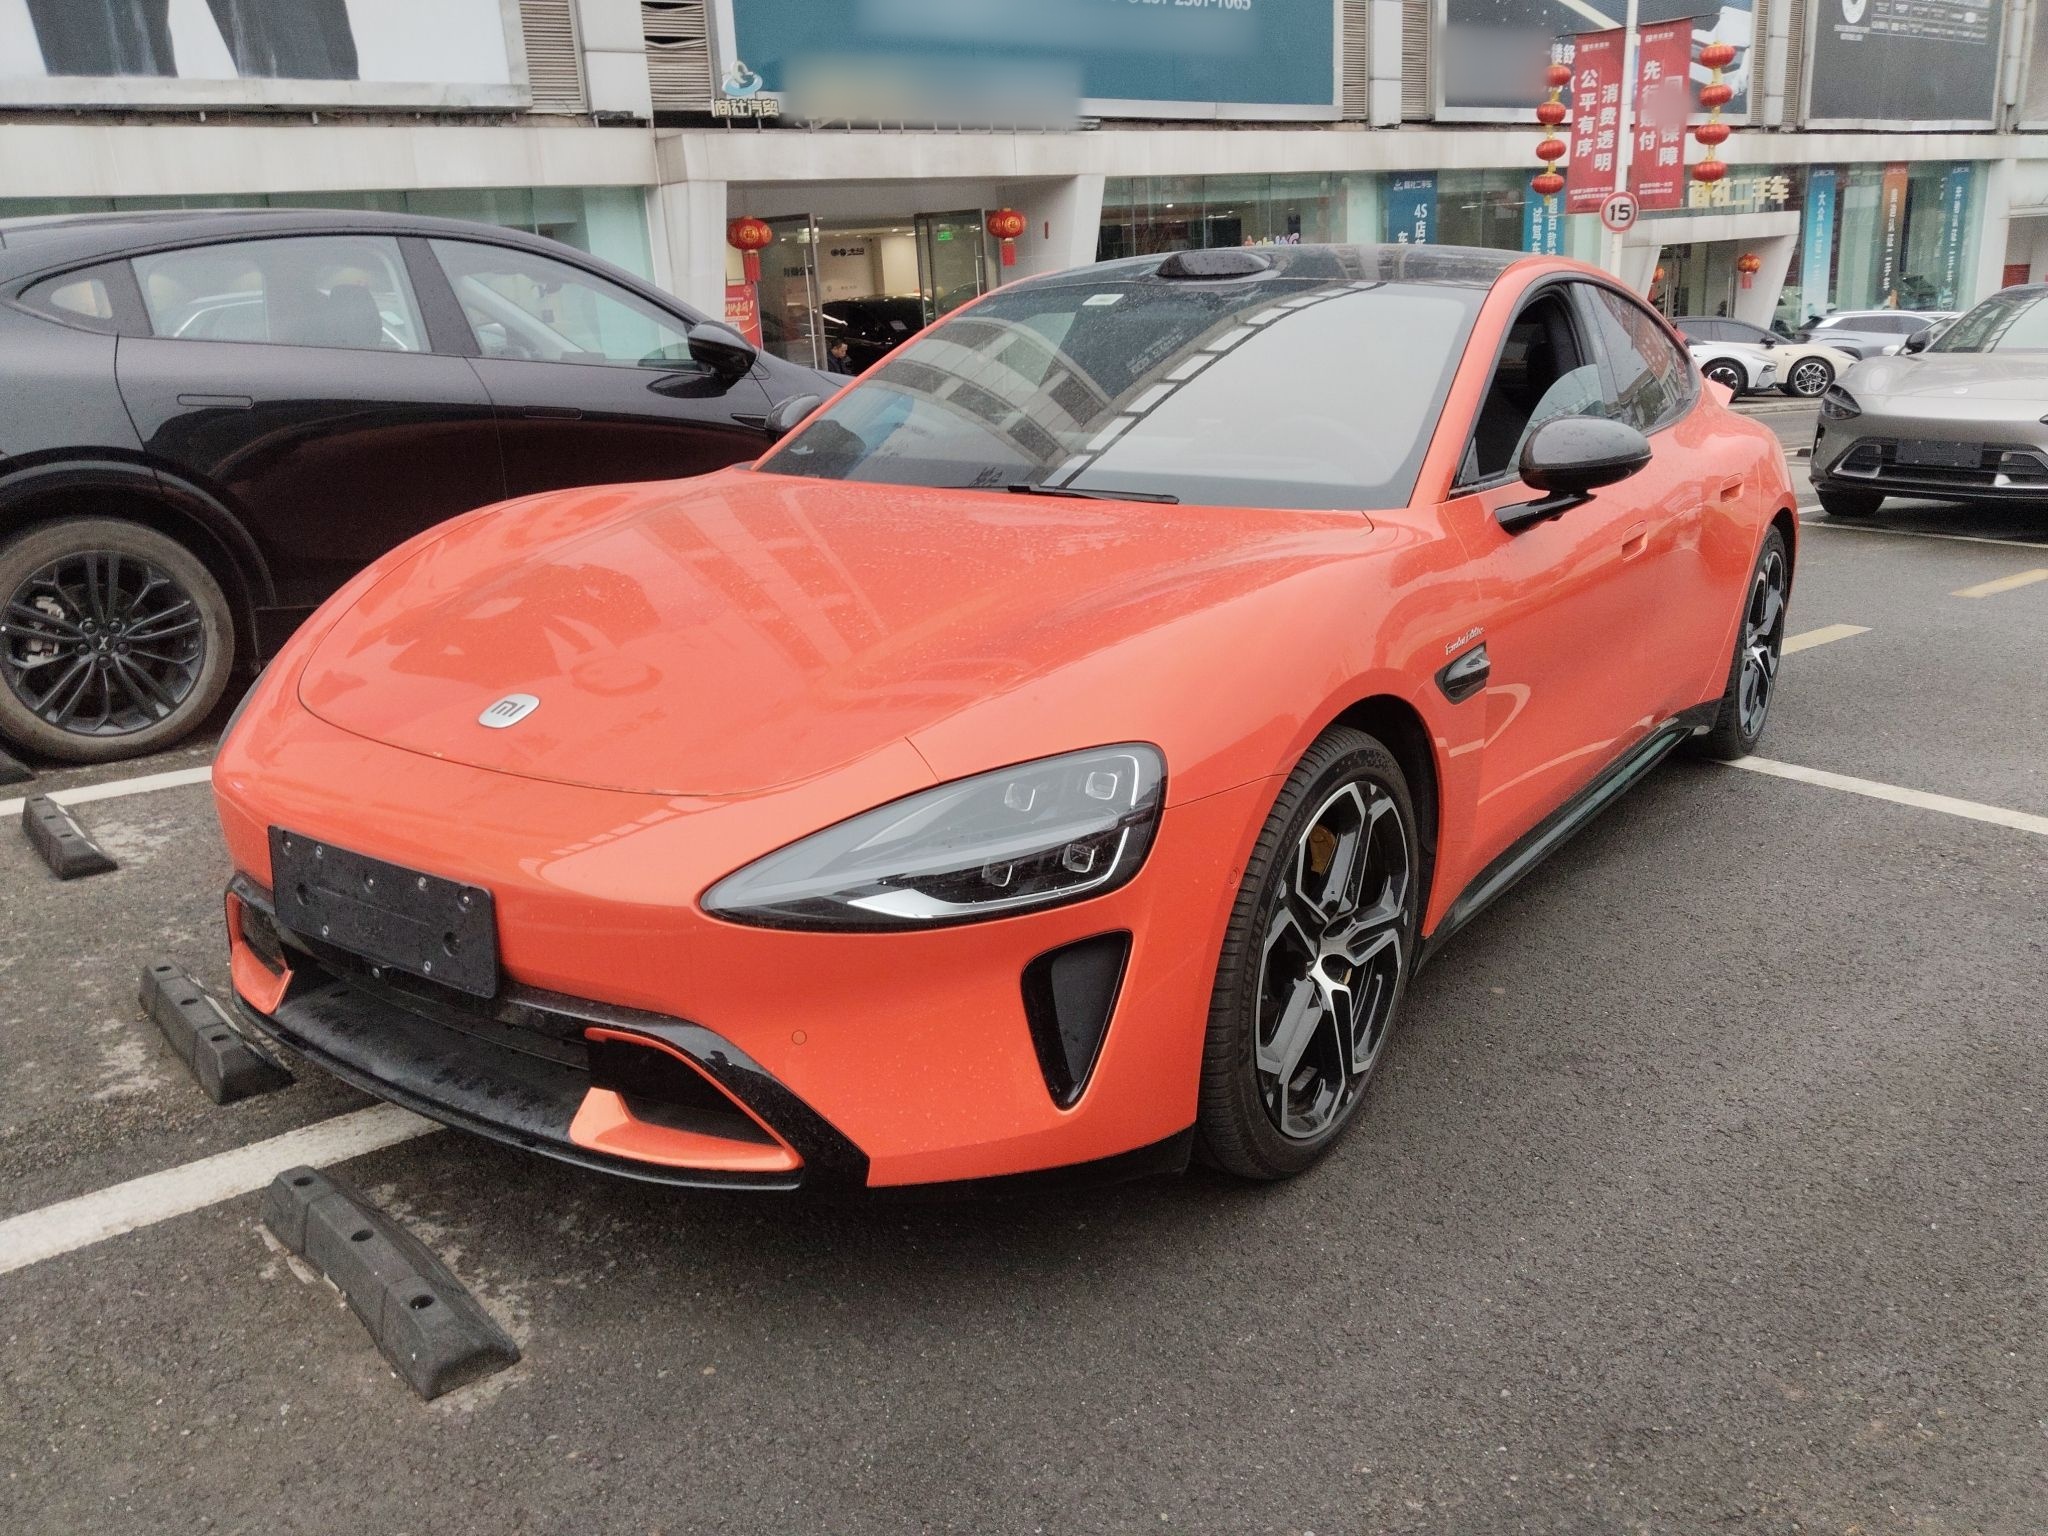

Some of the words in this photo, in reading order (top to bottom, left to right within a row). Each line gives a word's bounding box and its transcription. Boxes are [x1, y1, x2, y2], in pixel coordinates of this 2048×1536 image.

[714, 100, 779, 117] 商社汽贸
[1575, 69, 1598, 158] 公平有序
[1594, 83, 1619, 172] 消费透明
[1610, 204, 1630, 221] 15
[1688, 175, 1790, 213] 商社二手车
